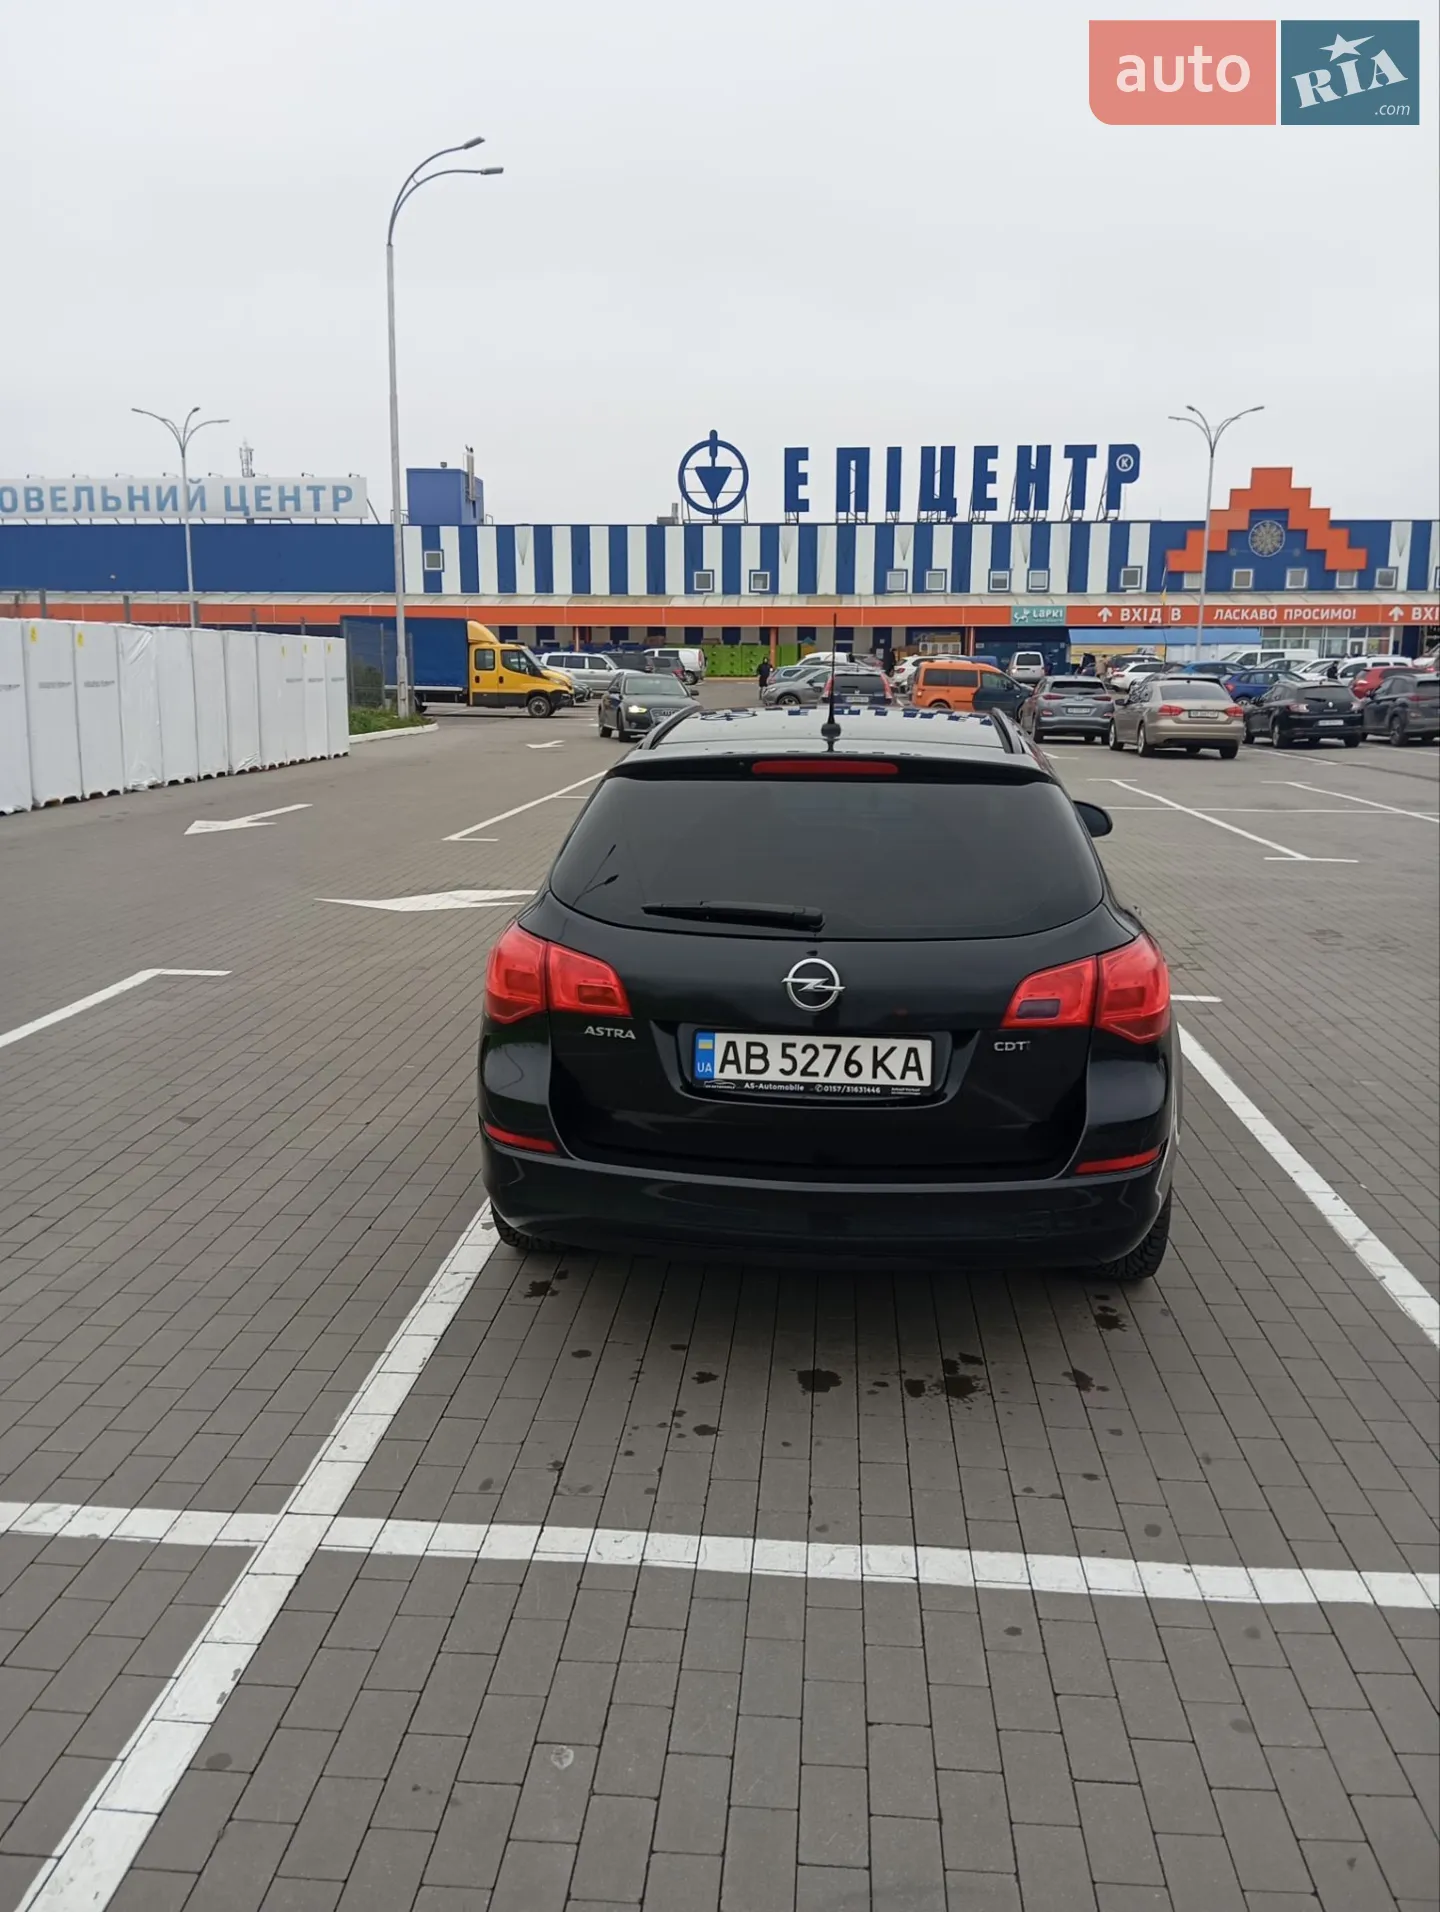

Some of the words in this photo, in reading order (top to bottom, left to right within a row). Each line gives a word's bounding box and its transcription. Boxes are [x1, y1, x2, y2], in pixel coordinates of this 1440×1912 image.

[784, 443, 1141, 517] ЕПІЦЕНТР
[0, 478, 207, 512] ОВЕЛЬНИЙ
[224, 485, 353, 516] ЦЕНТР
[1120, 607, 1163, 624] ВХІД
[1171, 607, 1182, 621] В
[1213, 608, 1278, 620] ЛАСКАВО
[1284, 607, 1357, 621] ПРОСИМО!
[584, 1025, 636, 1040] ASTRA
[697, 1062, 713, 1072] UA
[719, 1041, 770, 1075] AB
[779, 1042, 863, 1078] 5276
[872, 1045, 924, 1081] KA
[744, 1082, 805, 1092] AS-Automobile
